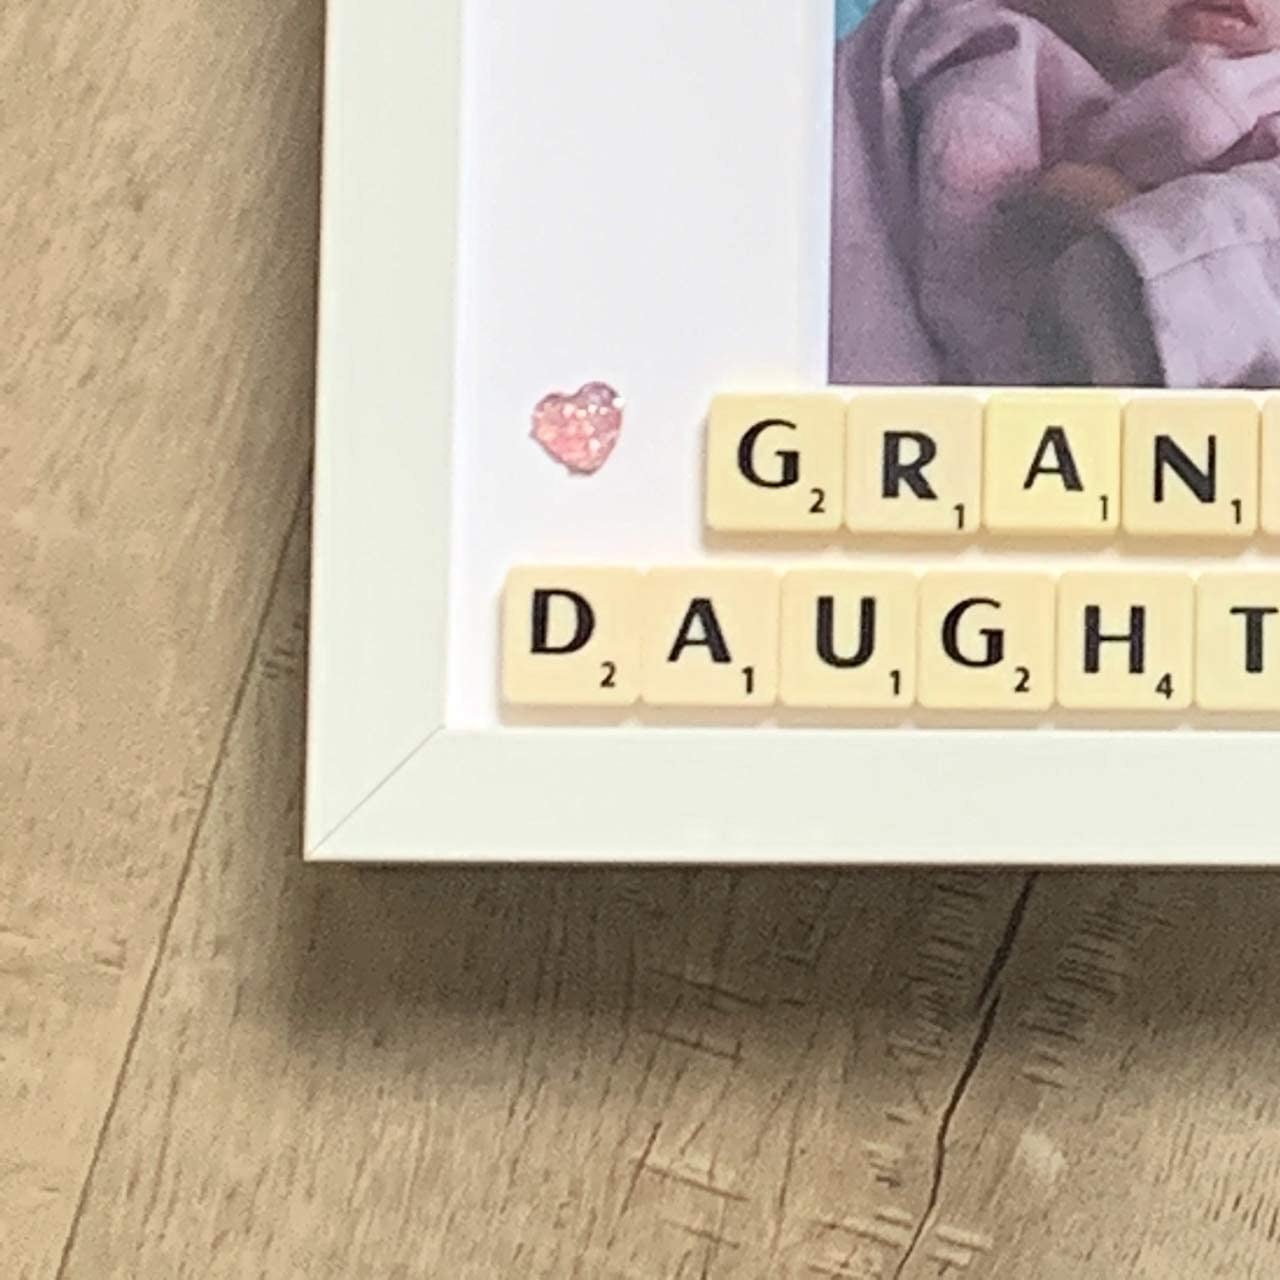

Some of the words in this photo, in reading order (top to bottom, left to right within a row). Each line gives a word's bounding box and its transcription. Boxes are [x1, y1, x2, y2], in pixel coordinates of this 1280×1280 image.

[808, 488, 827, 514] 2
[953, 503, 967, 530] 1
[1097, 495, 1110, 522] 1
[1229, 498, 1244, 525] 1
[599, 661, 618, 688] 2
[741, 666, 756, 694] 1
[887, 668, 902, 695] 1
[1013, 666, 1032, 693] 2
[1154, 672, 1175, 699] 4
